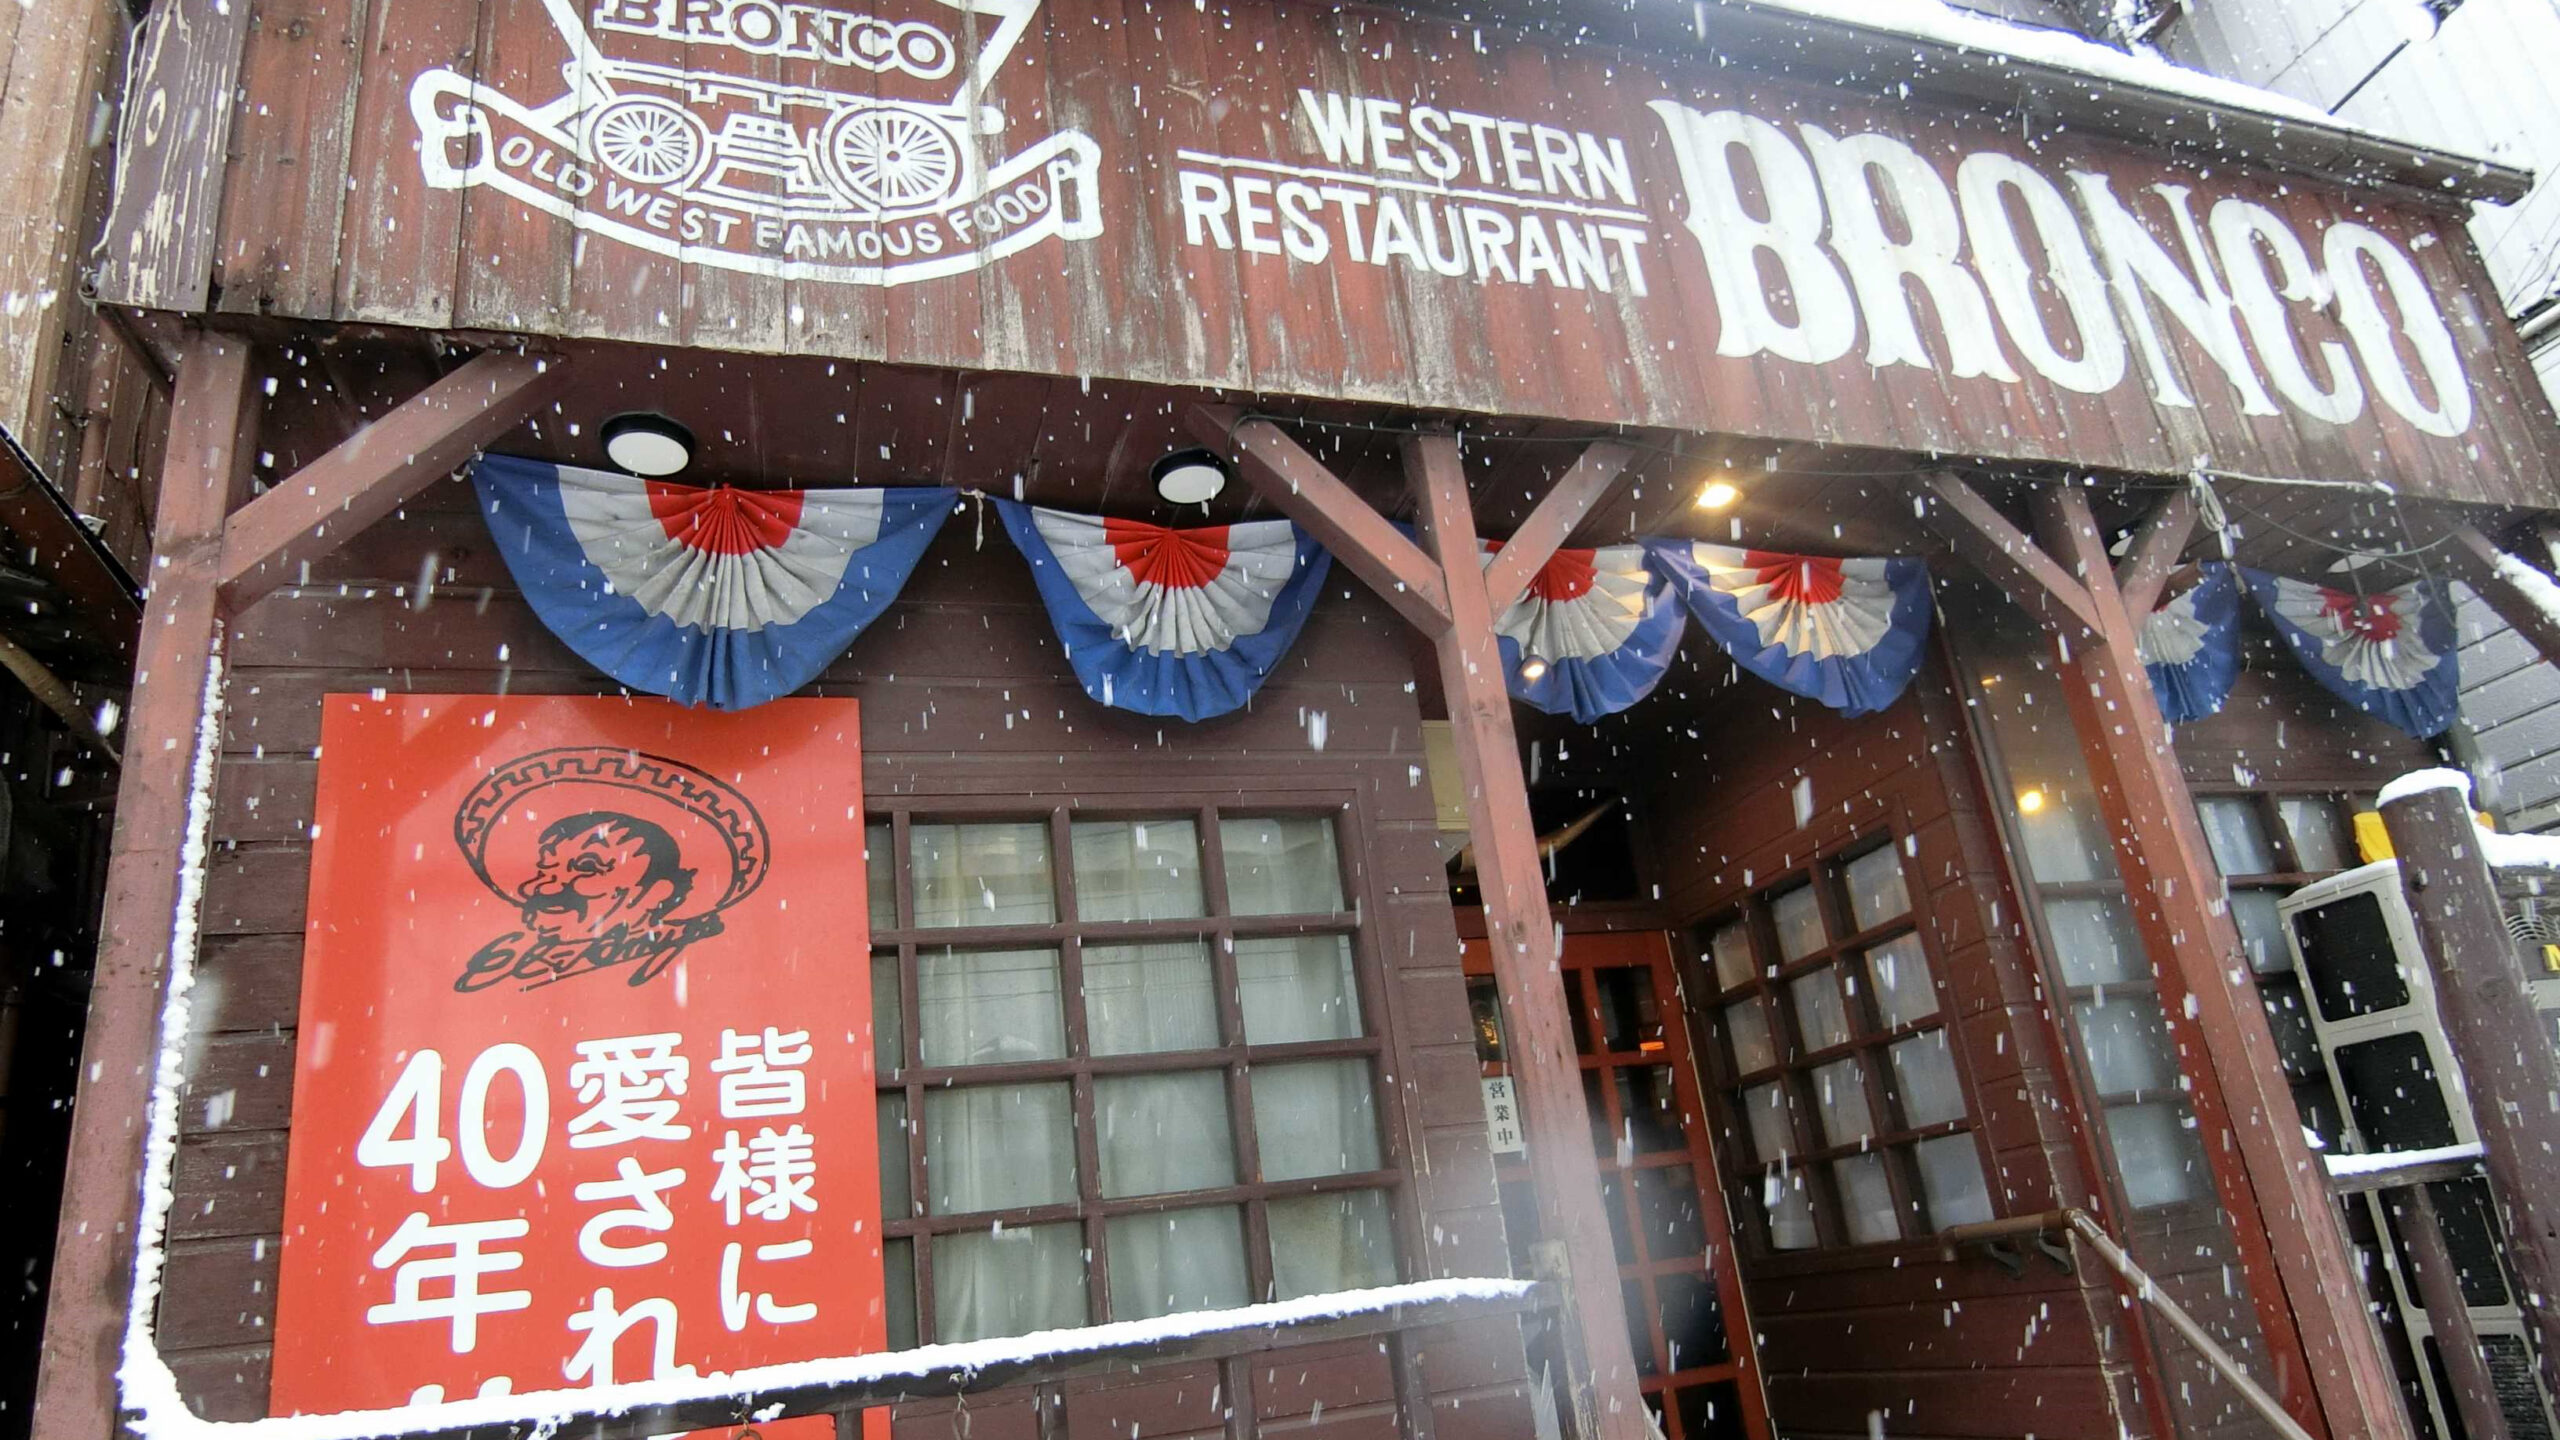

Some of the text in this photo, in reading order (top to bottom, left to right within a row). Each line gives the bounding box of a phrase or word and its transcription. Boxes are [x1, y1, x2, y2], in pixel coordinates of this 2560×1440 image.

[593, 0, 956, 80] BRONCO
[500, 136, 594, 197] OLD
[606, 181, 742, 247] WEST
[948, 182, 1048, 244] FOOD
[1298, 89, 1638, 205] WESTERN
[1179, 171, 1649, 297] RESTAURANT
[1646, 99, 2474, 437] BRONCO
[1489, 1081, 1513, 1145] 営業中
[356, 1042, 550, 1405] 40年
[563, 1032, 697, 1386] 愛され
[710, 1027, 819, 1332] 皆様に
